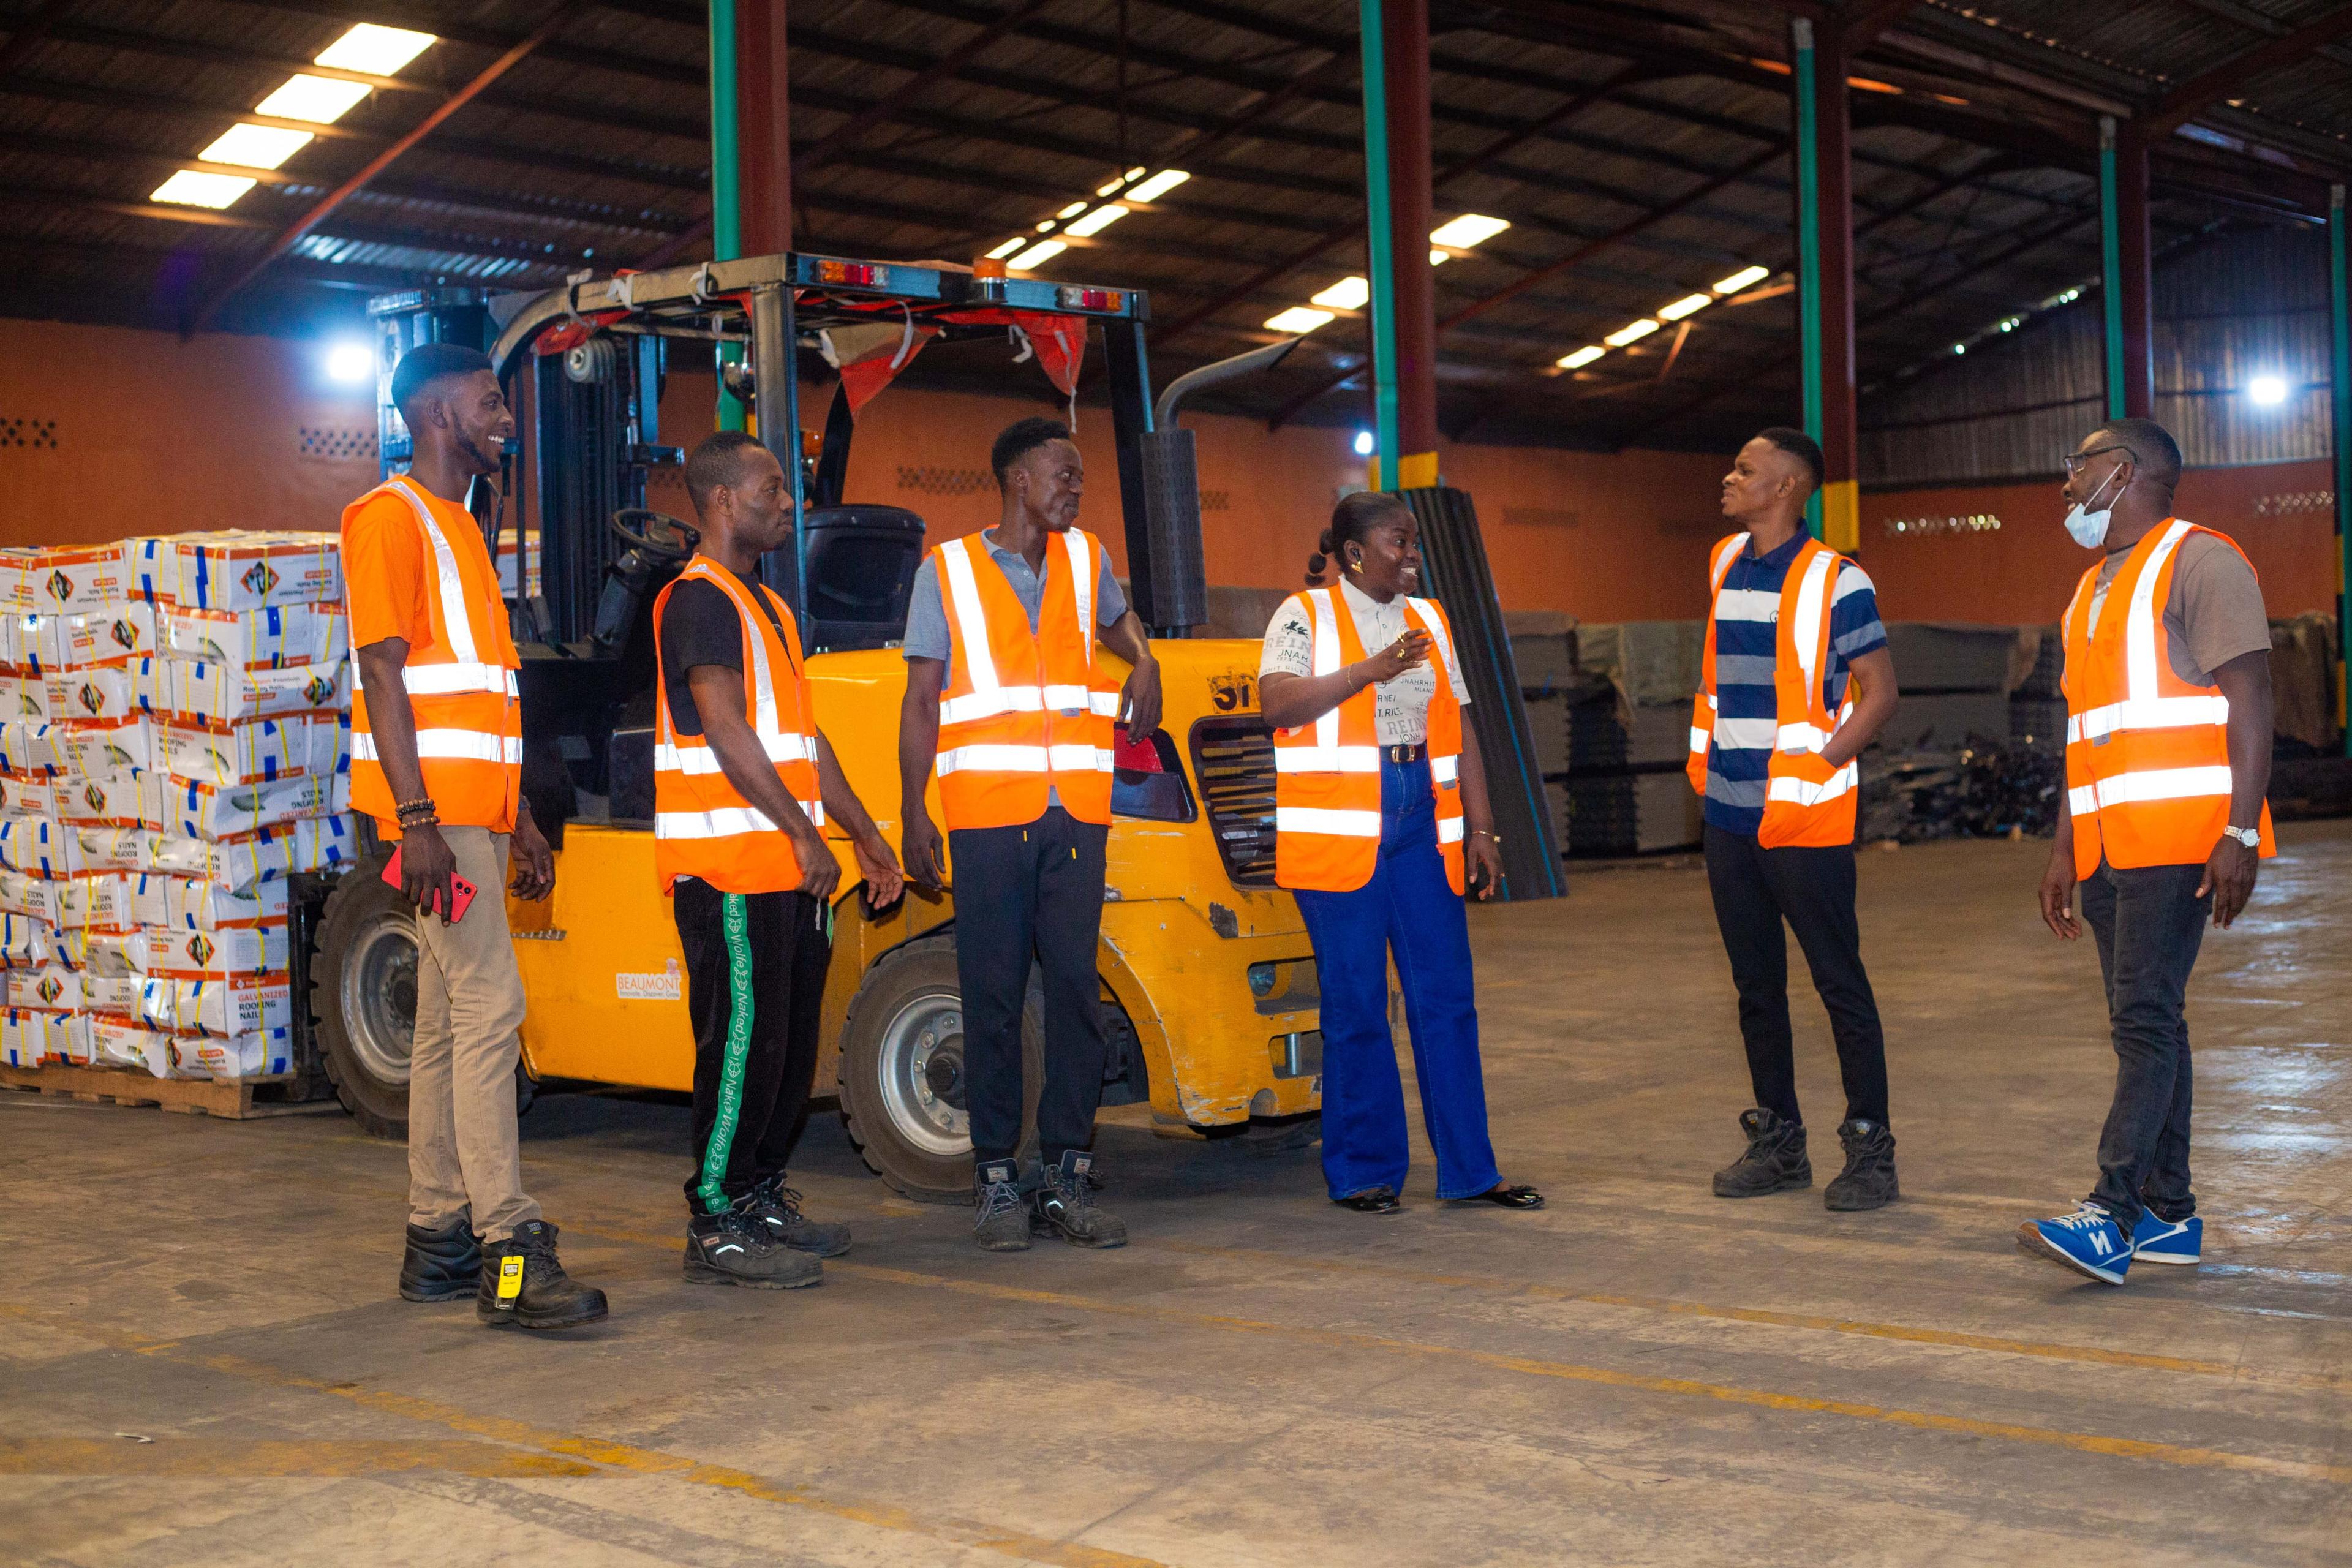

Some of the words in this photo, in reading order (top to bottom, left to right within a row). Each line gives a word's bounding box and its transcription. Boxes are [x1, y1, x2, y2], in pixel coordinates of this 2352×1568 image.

[729, 935, 747, 968] Wolfe
[618, 976, 680, 990] BEAUMONT
[736, 992, 749, 1035] Naked
[714, 1114, 733, 1152] Wolfe
